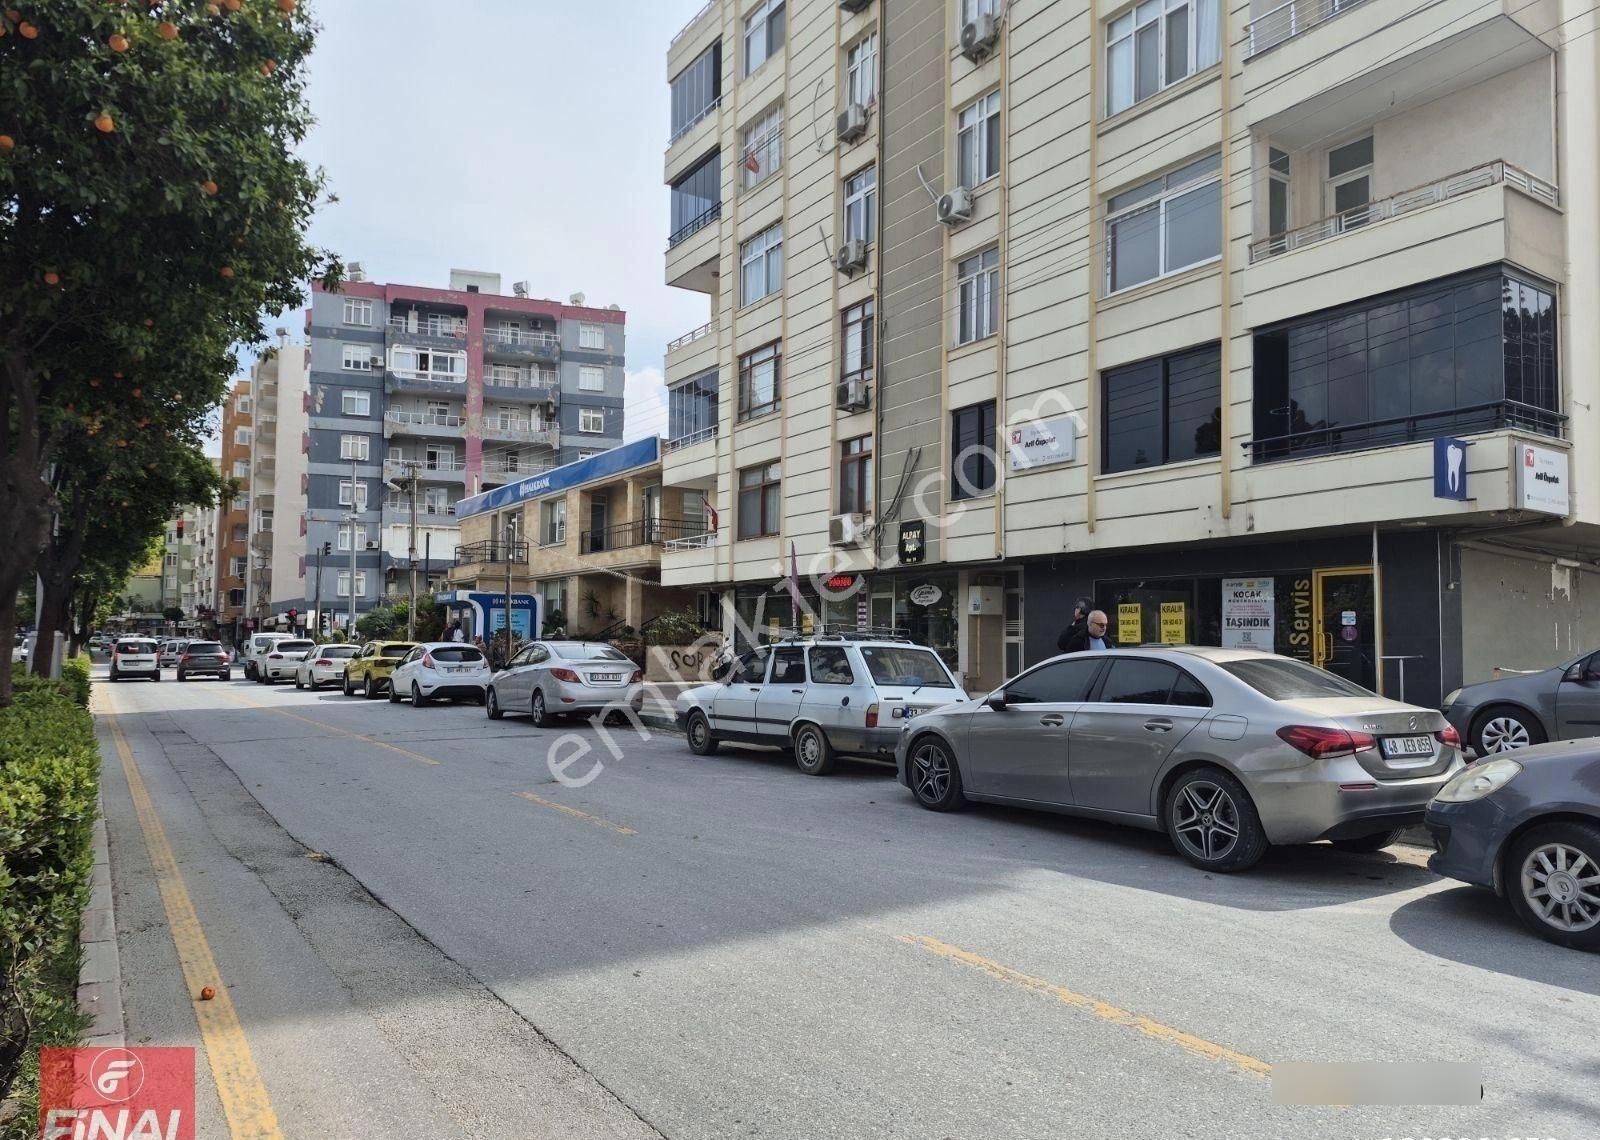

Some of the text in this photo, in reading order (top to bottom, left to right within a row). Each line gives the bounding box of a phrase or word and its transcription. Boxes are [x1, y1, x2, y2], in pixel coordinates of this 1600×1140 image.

[1290, 579, 1310, 645] Servis
[1388, 740, 1398, 753] 48
[1417, 738, 1431, 751] 855
